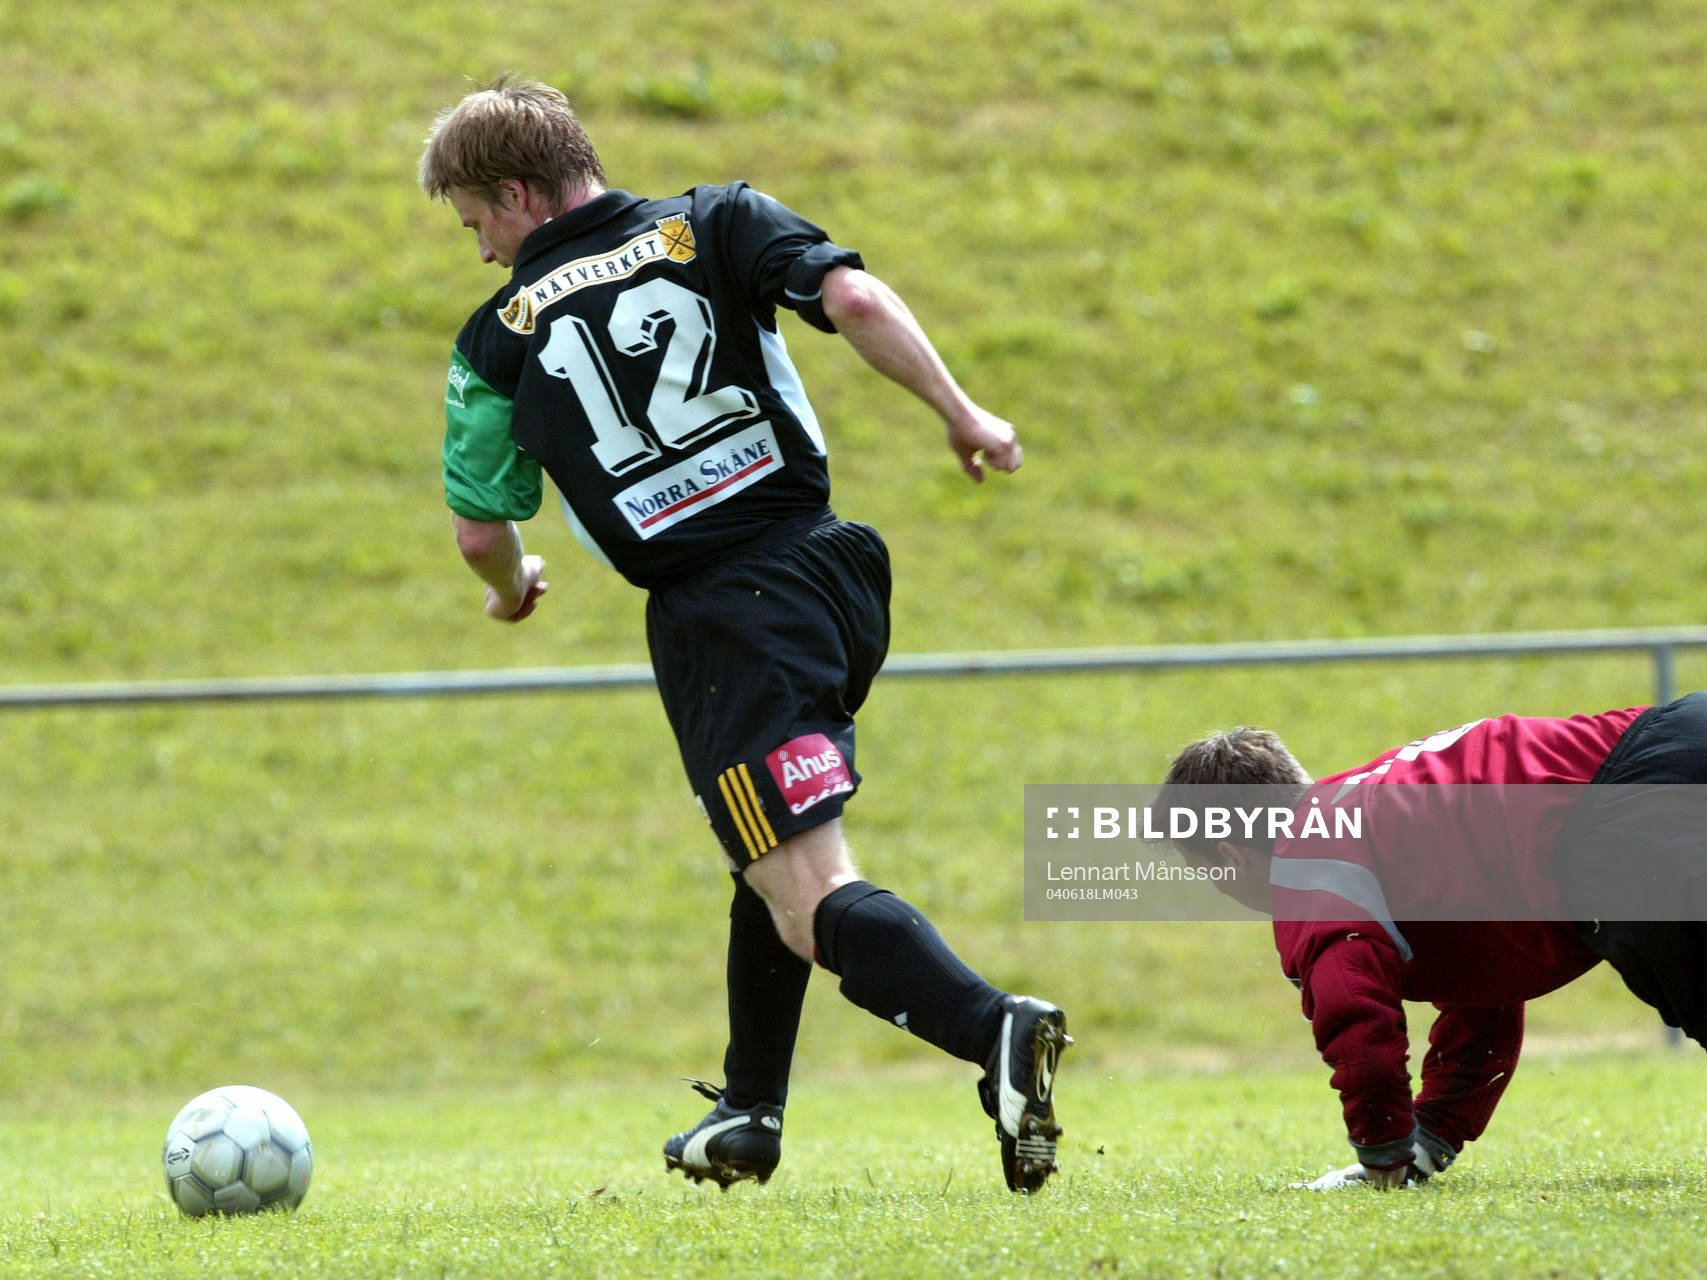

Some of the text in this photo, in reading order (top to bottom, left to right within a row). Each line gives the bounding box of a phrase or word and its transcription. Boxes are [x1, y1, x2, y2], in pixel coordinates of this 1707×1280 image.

[535, 240, 656, 303] NÄTVERKET
[538, 277, 761, 477] 12
[625, 438, 771, 522] NORRA SKÅNE
[778, 750, 841, 789] Åhus
